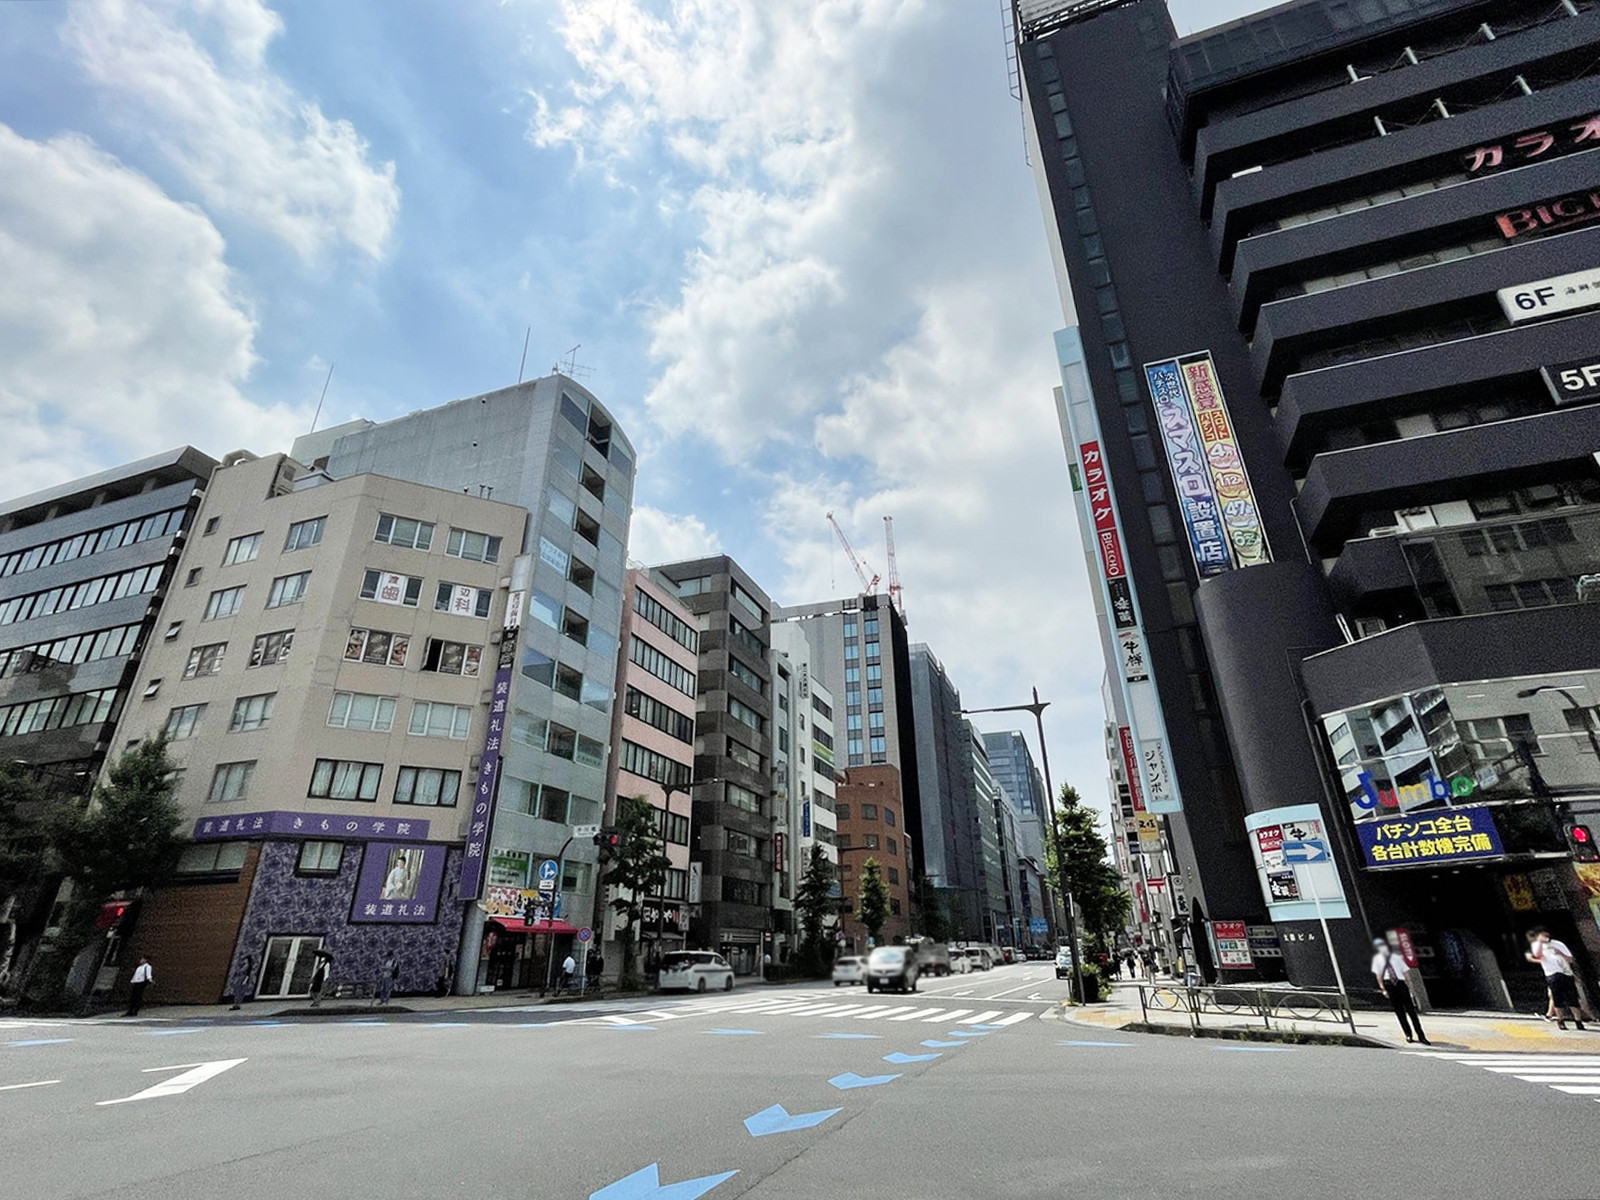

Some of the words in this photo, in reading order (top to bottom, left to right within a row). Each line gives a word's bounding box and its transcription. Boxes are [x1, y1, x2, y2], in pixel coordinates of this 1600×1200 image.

[1514, 286, 1555, 310] 6F
[1560, 364, 1600, 391] 5F
[1084, 450, 1111, 521] カラオケ
[1101, 532, 1113, 550] BIG
[293, 816, 413, 836] きもの学院
[1375, 815, 1473, 841] パチンコ全台
[1371, 833, 1493, 862] 各台計数機完備
[364, 903, 426, 917] 装道礼法
